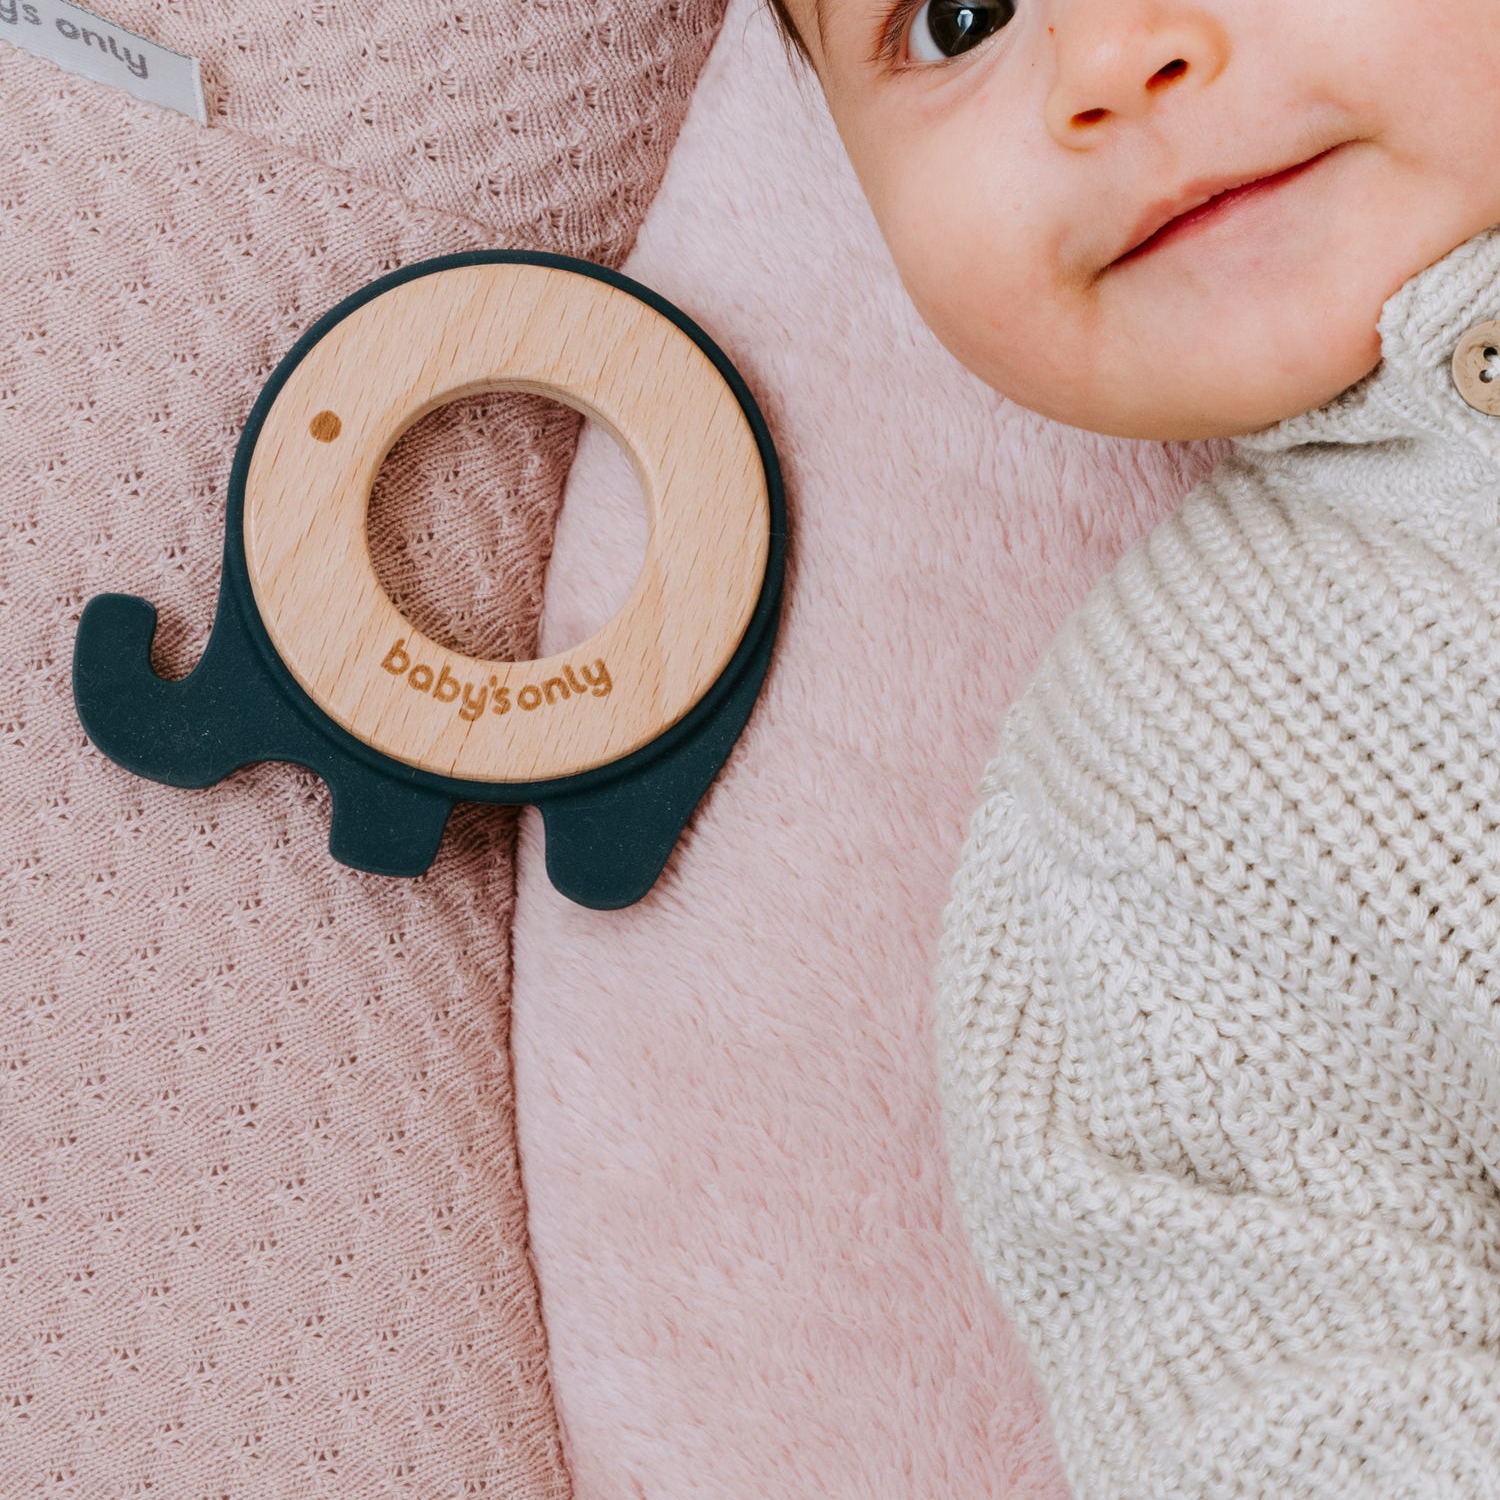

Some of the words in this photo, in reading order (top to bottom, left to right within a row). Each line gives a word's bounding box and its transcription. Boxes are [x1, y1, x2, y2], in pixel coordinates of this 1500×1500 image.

[55, 17, 149, 80] only
[380, 638, 512, 722] baby's
[516, 658, 613, 712] only
